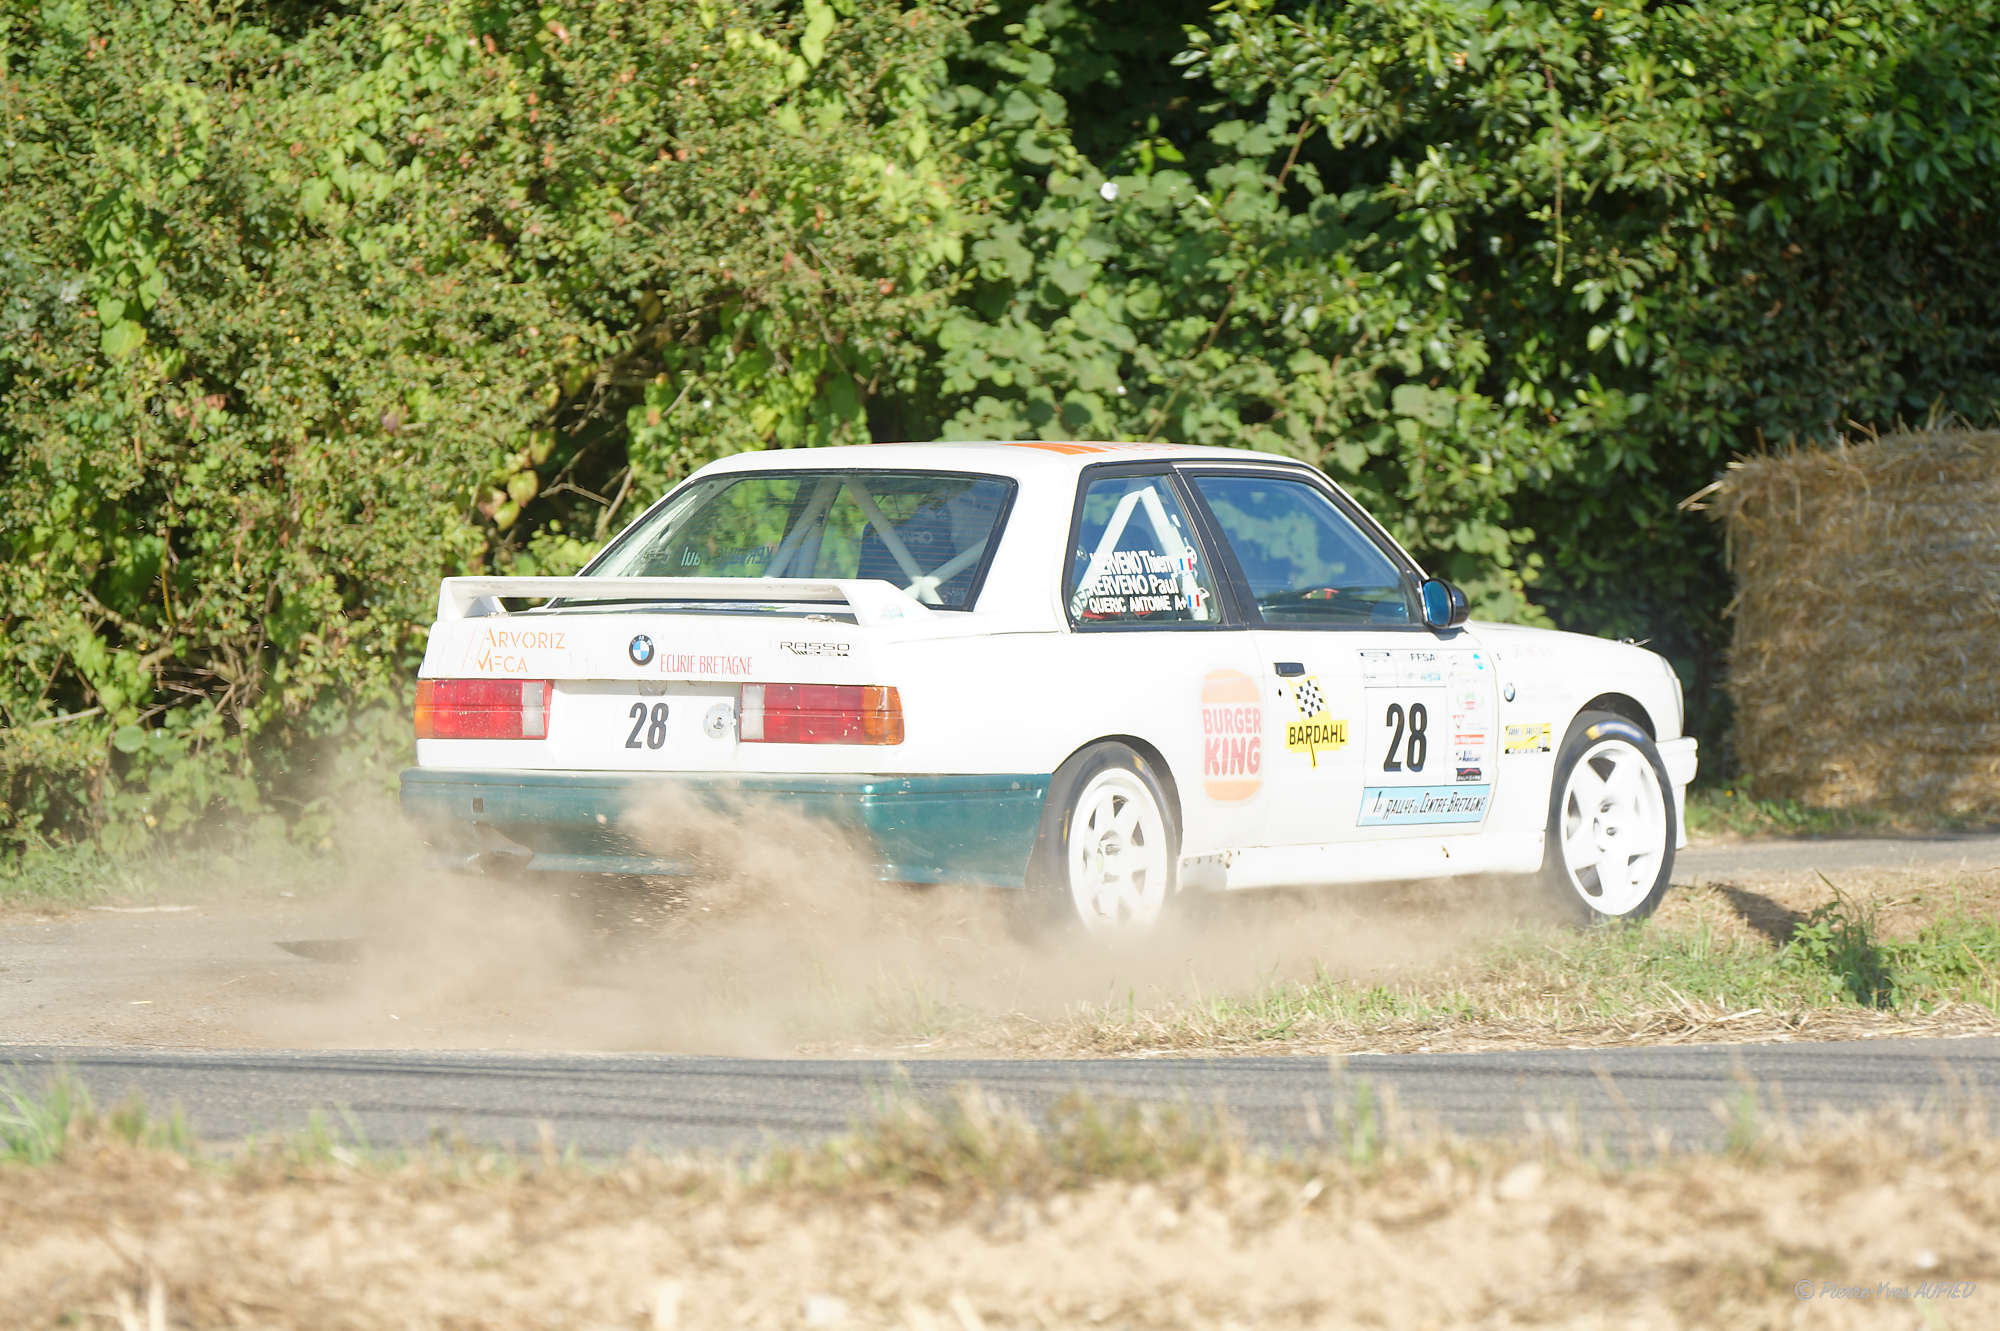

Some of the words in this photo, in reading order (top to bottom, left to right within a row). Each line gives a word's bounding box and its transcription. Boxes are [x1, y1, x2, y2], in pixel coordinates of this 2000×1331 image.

[1089, 550, 1143, 575] ERVENO
[1088, 574, 1148, 597] KERVENO
[1148, 573, 1179, 594] Paul
[1130, 595, 1172, 612] ANTOINE
[483, 627, 566, 649] ARVORIZ
[780, 641, 850, 652] RASSO
[660, 653, 696, 673] ECURIE
[699, 655, 753, 676] BRETAGNE
[1410, 652, 1436, 662] FFSA
[625, 702, 669, 749] 28
[1202, 706, 1262, 735] BURGER
[1289, 724, 1345, 745] BARDAHL
[1383, 702, 1428, 772] 28
[1204, 736, 1262, 776] KING
